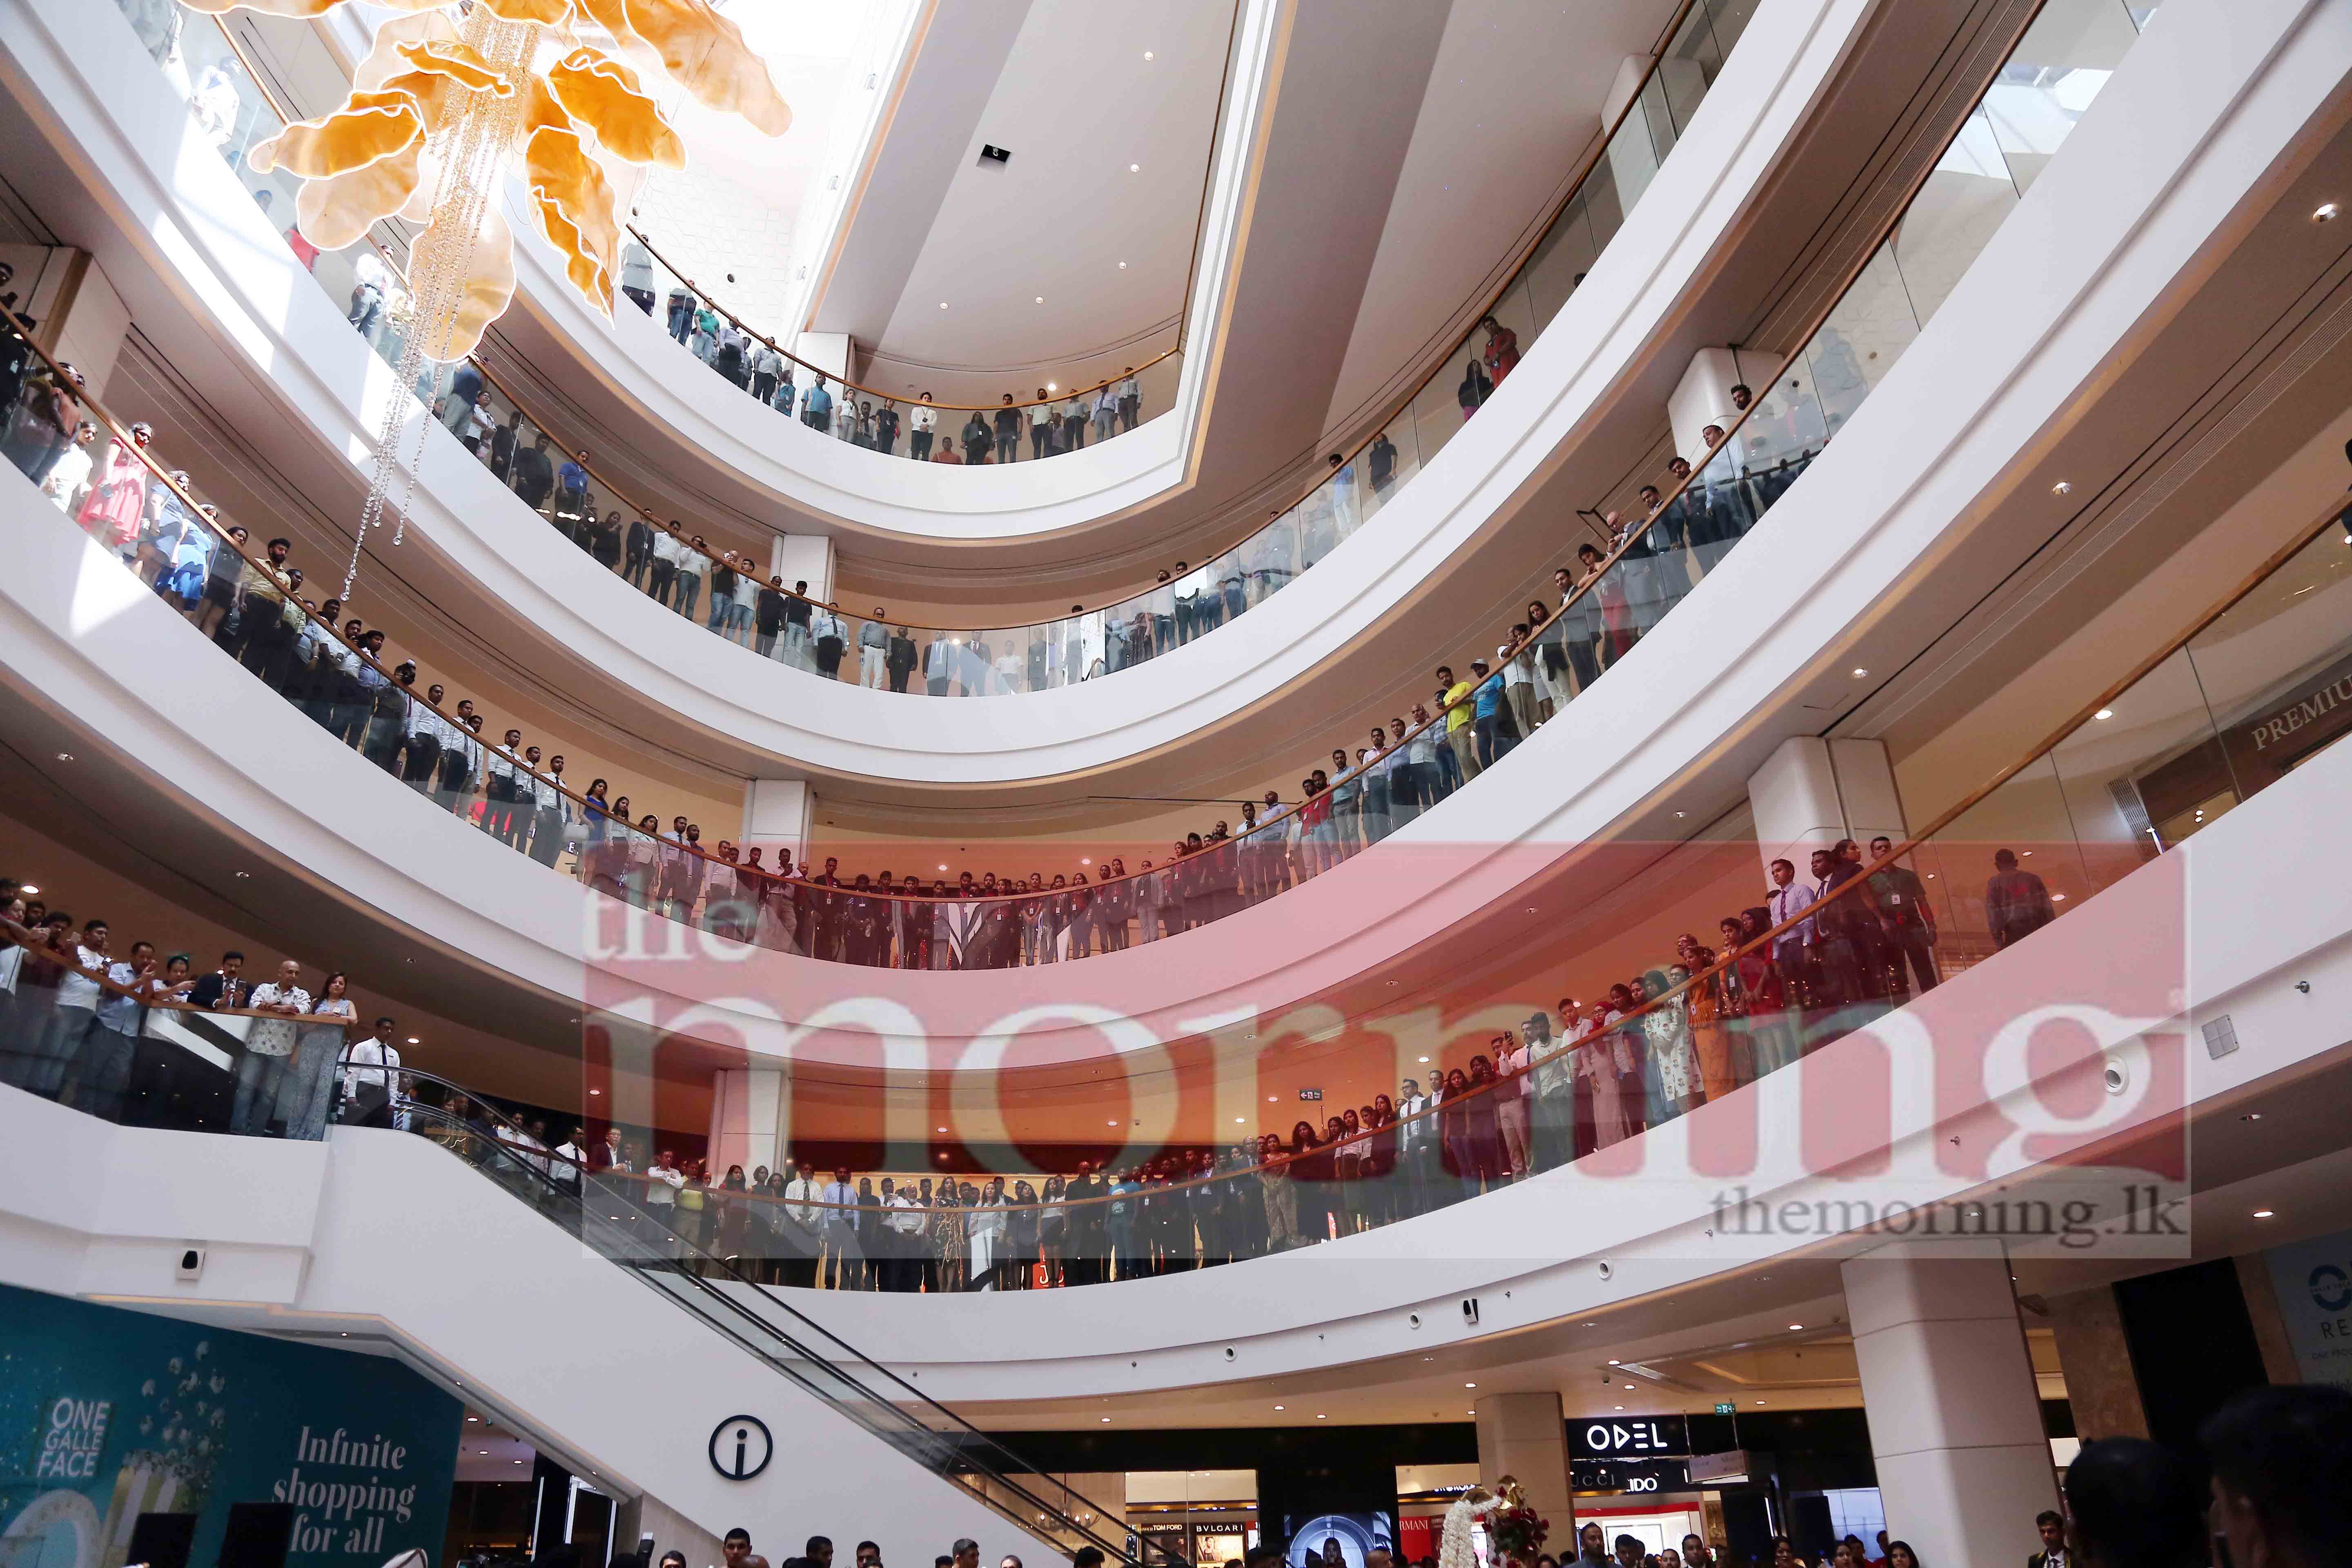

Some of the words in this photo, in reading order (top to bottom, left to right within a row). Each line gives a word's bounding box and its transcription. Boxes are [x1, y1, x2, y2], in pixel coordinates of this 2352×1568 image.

[52, 1398, 110, 1431] ONE
[45, 1429, 103, 1450] GALLE
[297, 1425, 406, 1470] Infinite
[1587, 1423, 1668, 1450] ODEL
[37, 1450, 99, 1477] FACE
[272, 1468, 416, 1523] shopping
[1626, 1477, 1657, 1492] IDO
[290, 1513, 339, 1552] for
[343, 1516, 385, 1553] all
